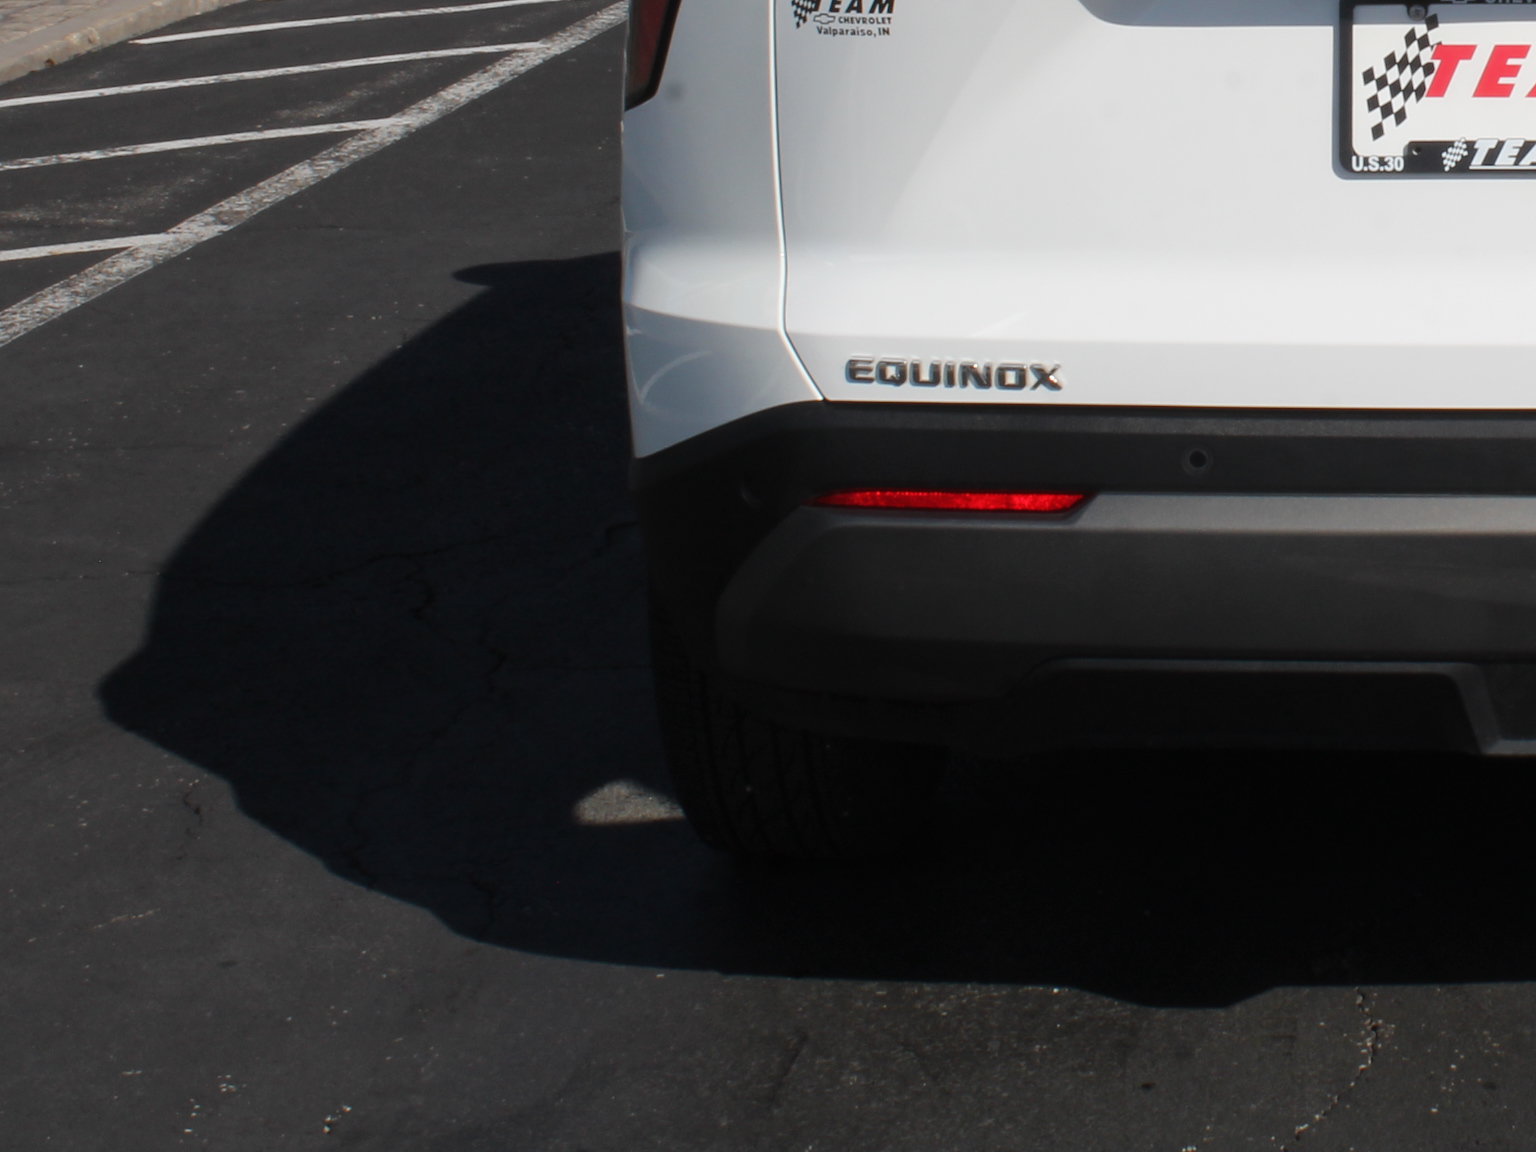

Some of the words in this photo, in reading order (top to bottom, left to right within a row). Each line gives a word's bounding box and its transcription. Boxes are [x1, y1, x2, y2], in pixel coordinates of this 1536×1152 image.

[838, 16, 892, 25] CHEVROLET
[816, 26, 877, 38] Valparaiso,
[878, 27, 891, 36] IN
[845, 356, 1064, 391] EQUINOX
